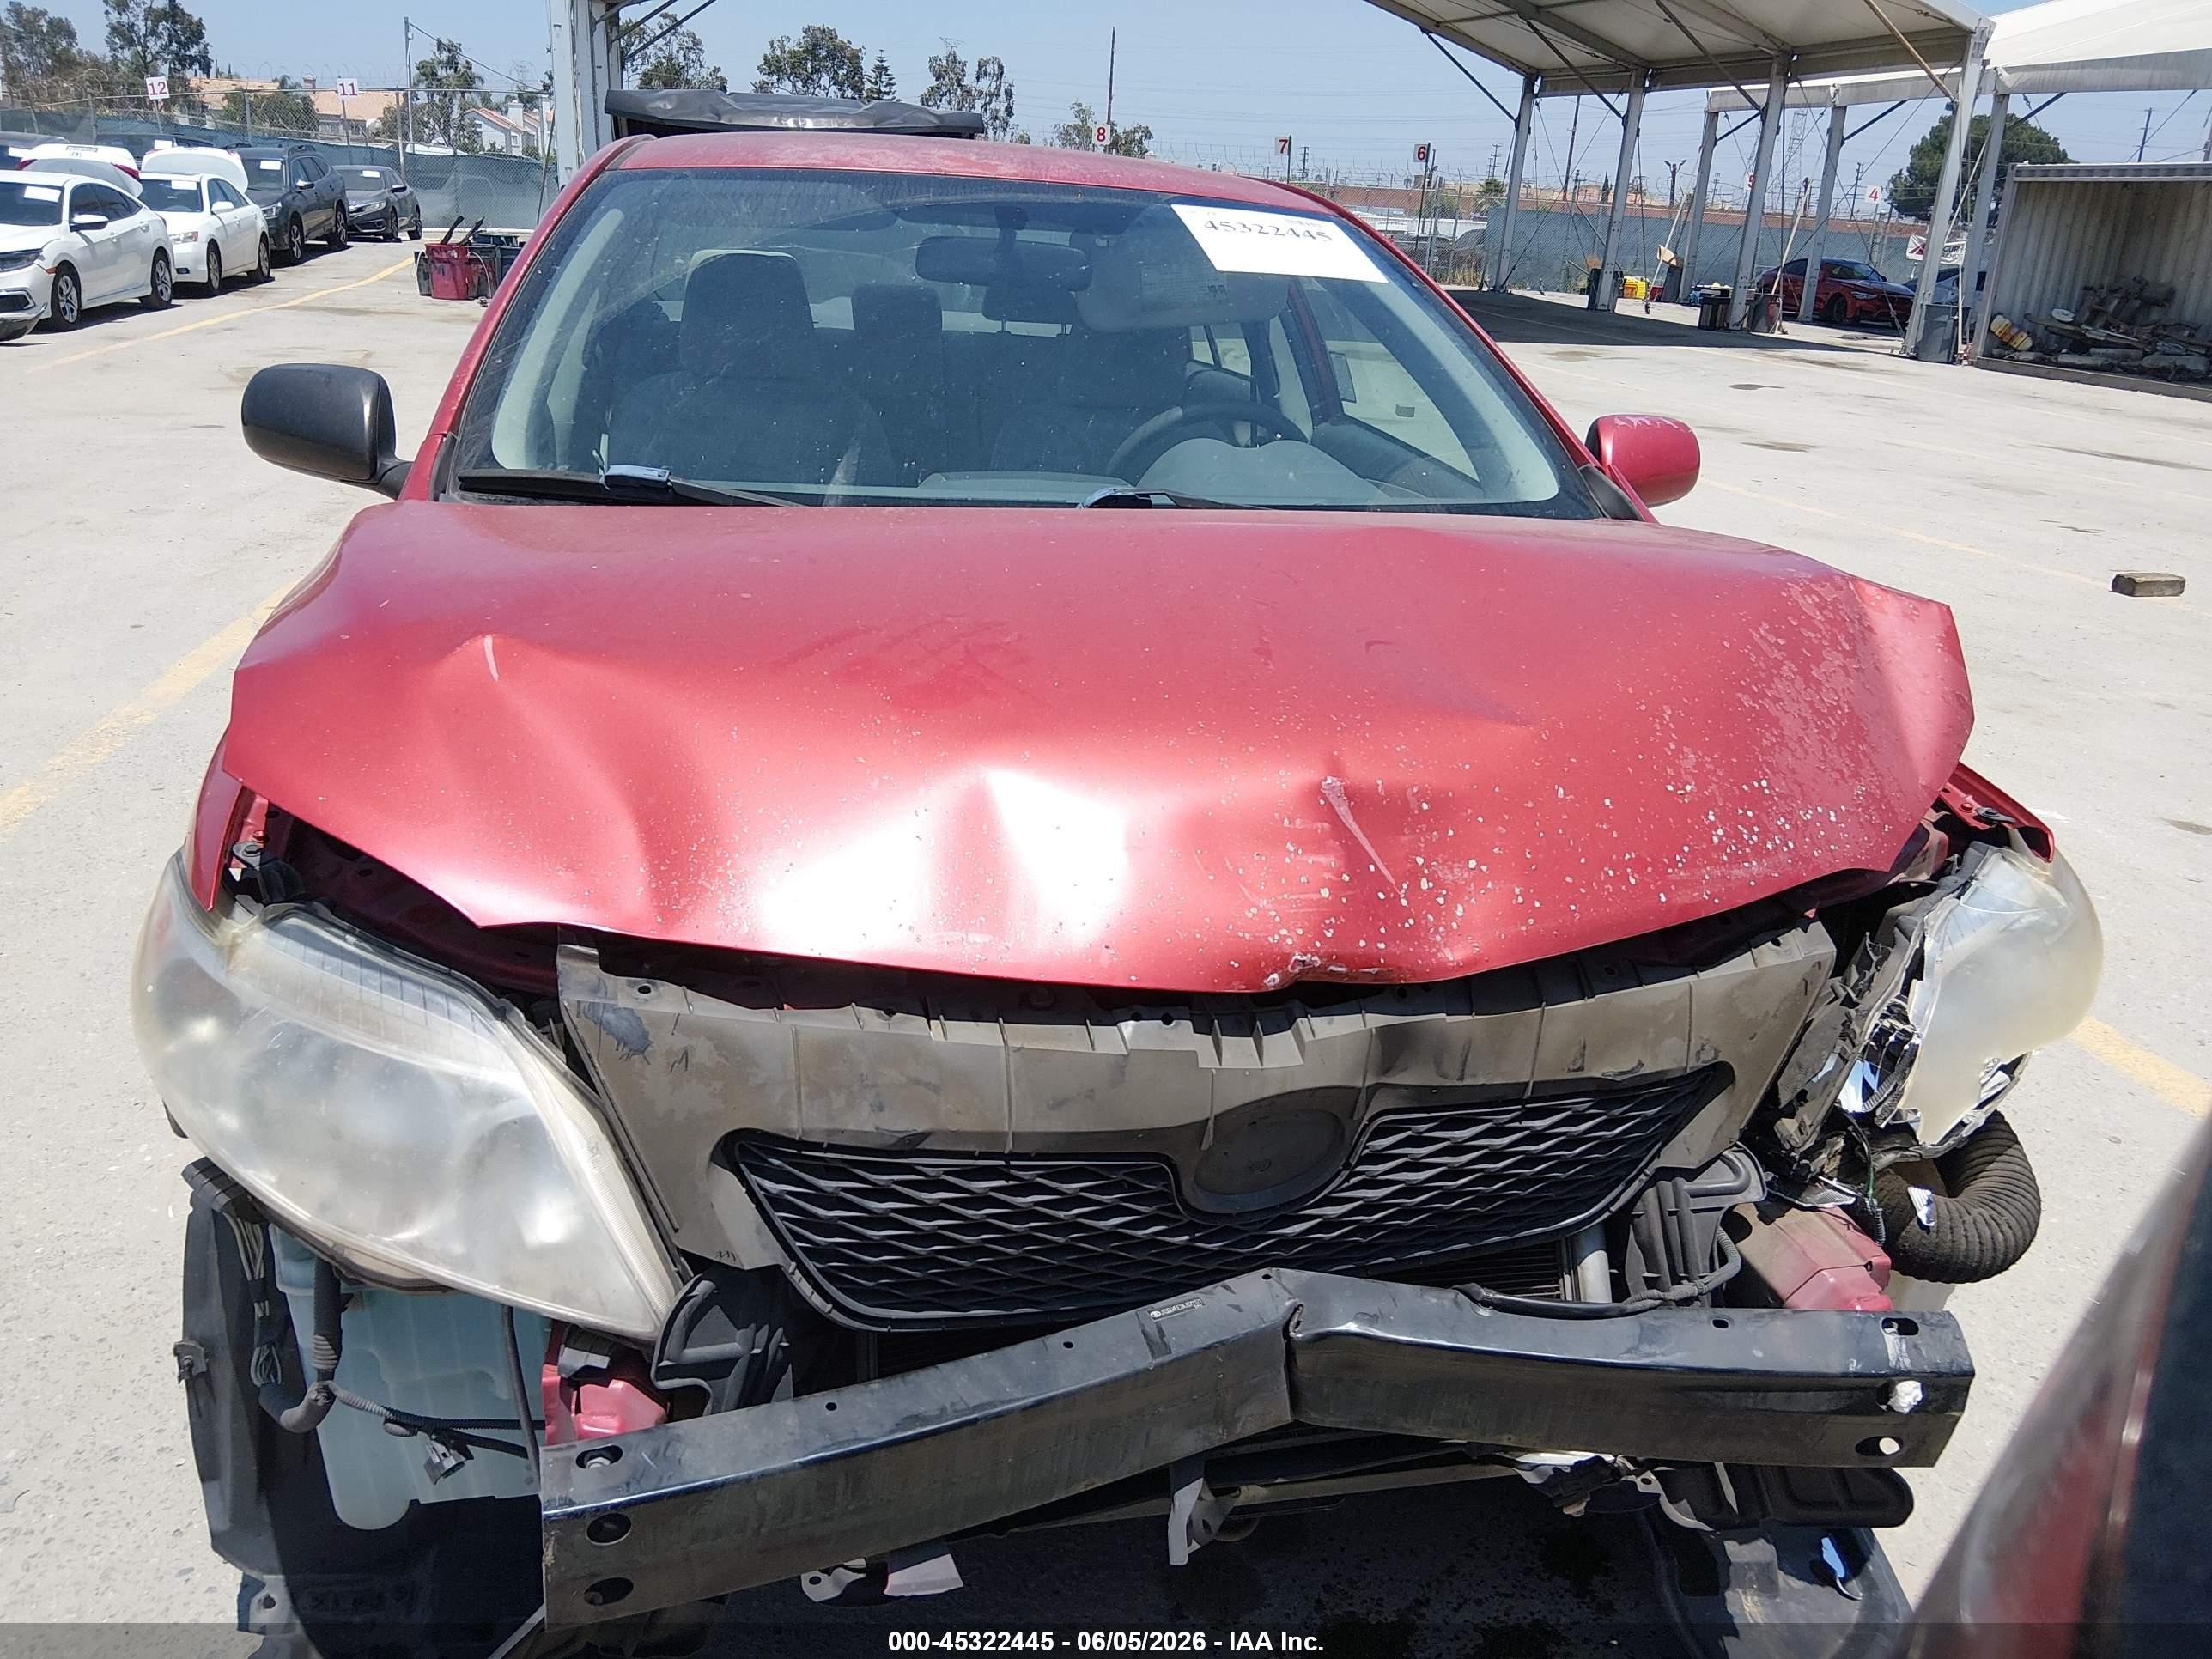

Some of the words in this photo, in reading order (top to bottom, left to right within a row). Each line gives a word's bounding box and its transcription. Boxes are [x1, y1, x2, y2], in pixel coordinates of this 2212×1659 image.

[149, 82, 167, 95] 12
[338, 82, 357, 95] 11
[1097, 126, 1106, 142] 8
[1278, 139, 1288, 154] 7
[1417, 146, 1426, 161] 6
[1869, 188, 1879, 202] 4
[1204, 220, 1333, 242] 45322445
